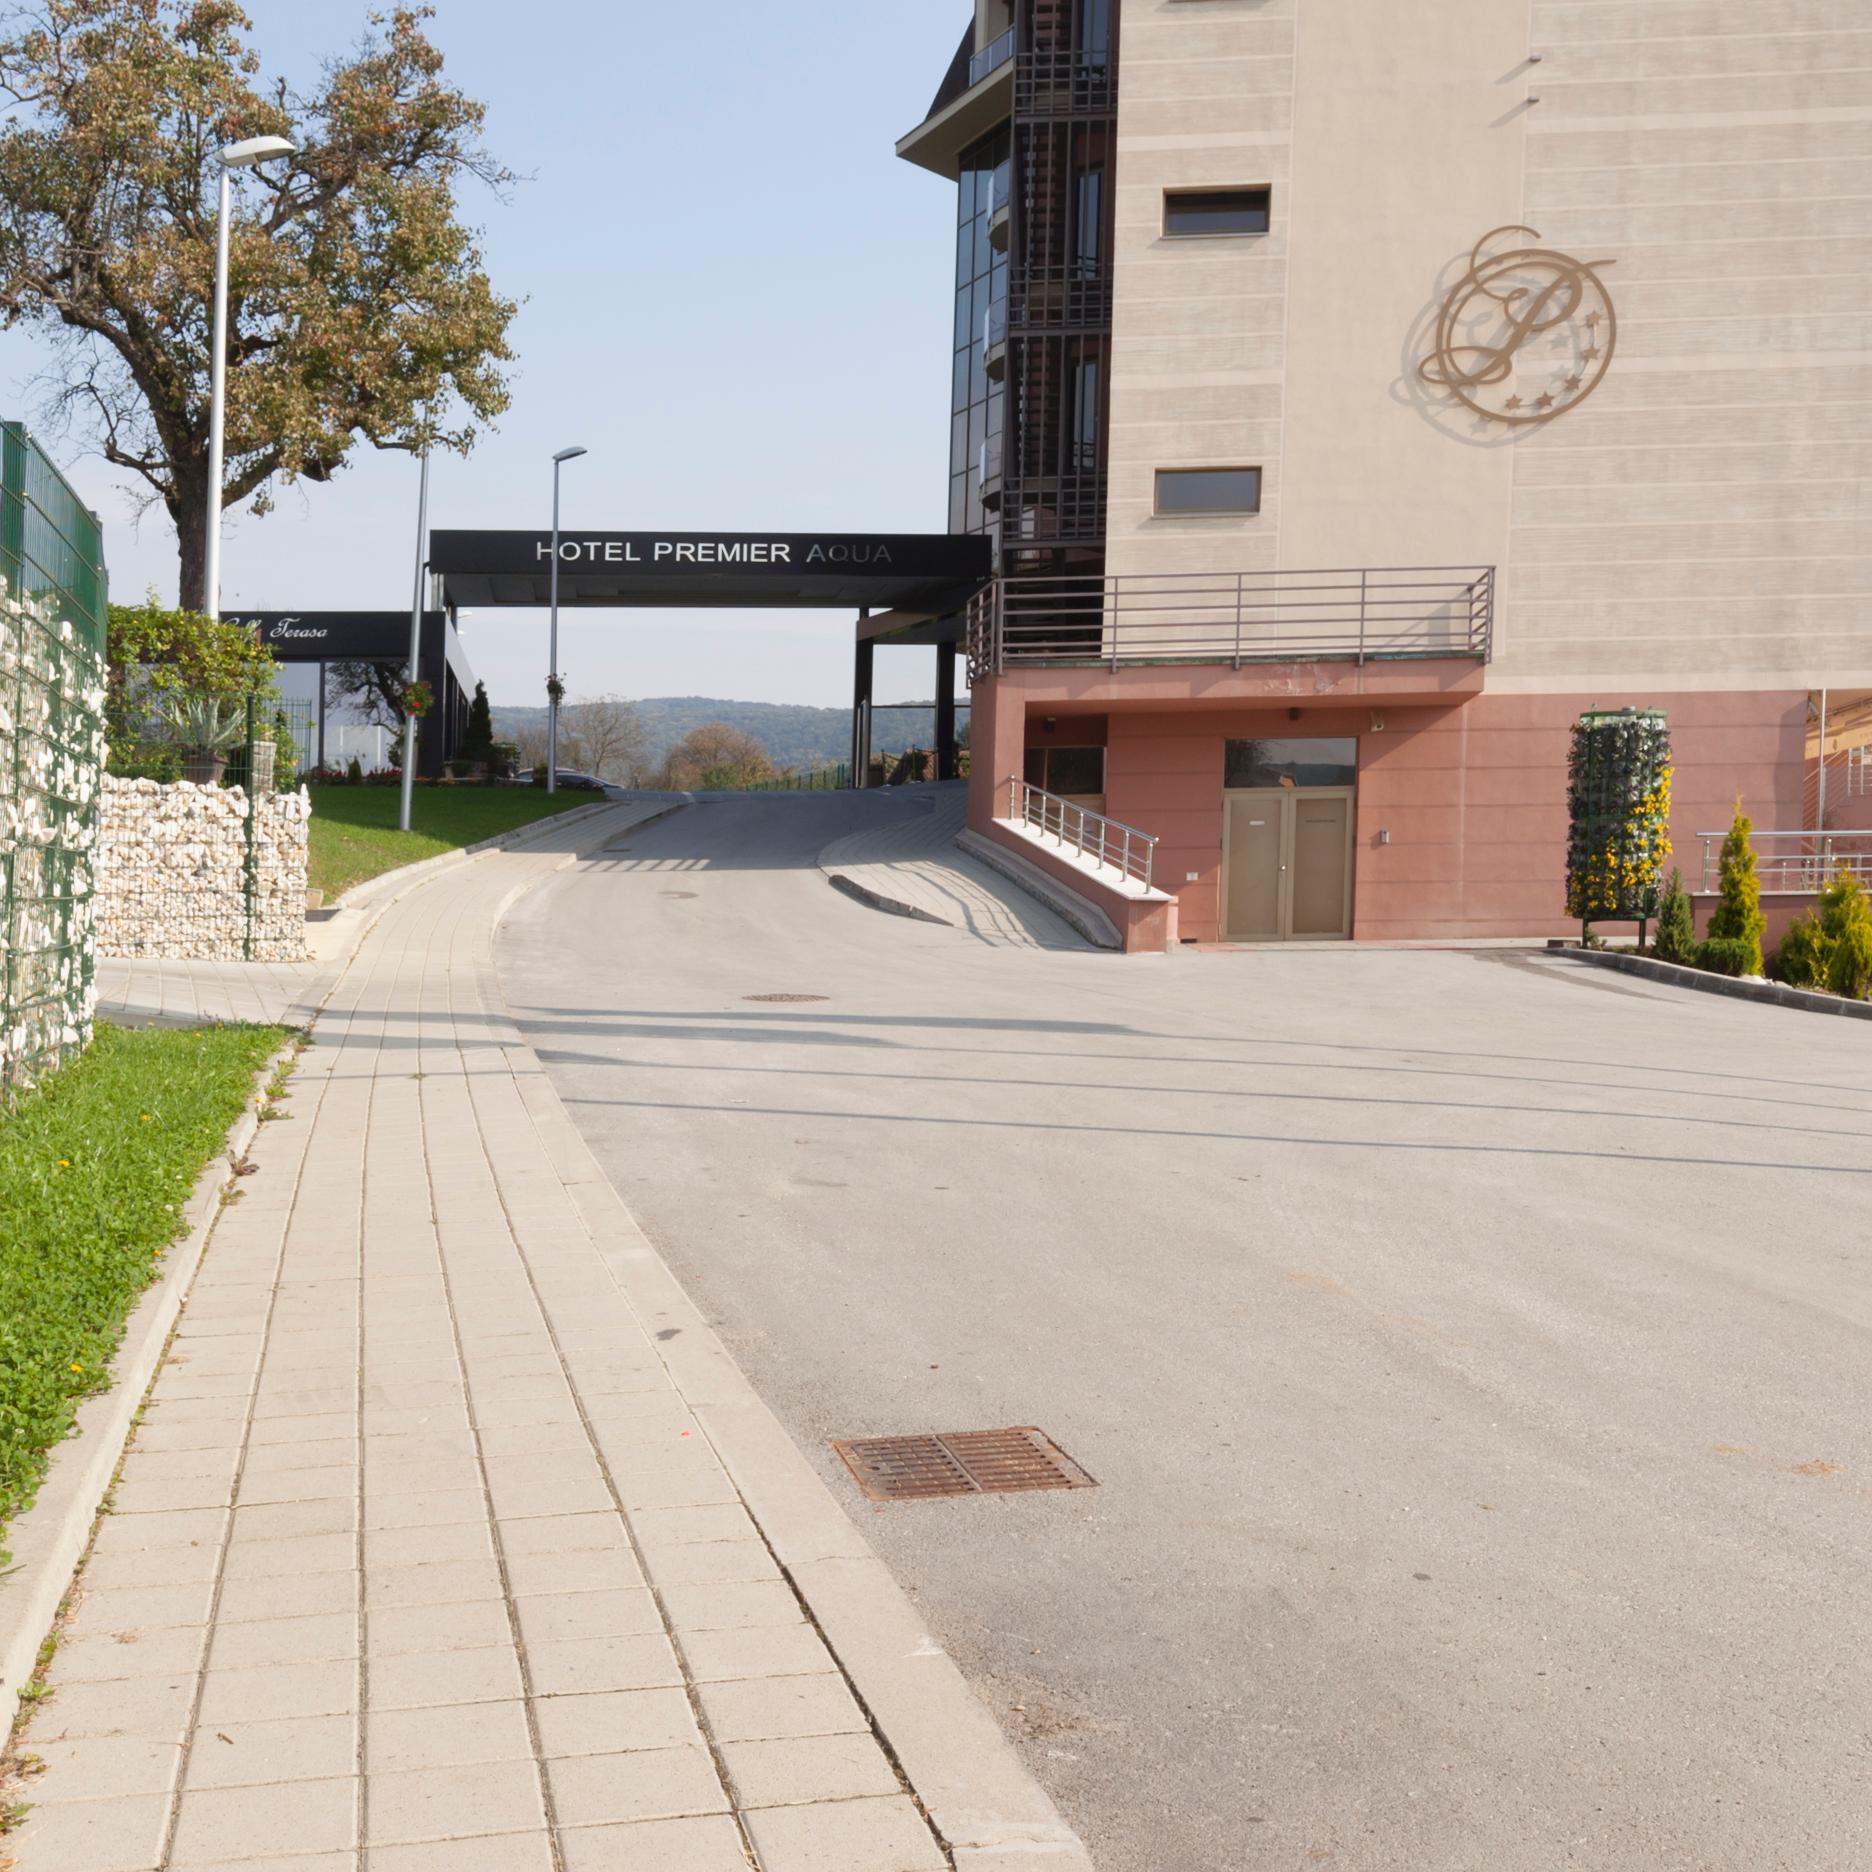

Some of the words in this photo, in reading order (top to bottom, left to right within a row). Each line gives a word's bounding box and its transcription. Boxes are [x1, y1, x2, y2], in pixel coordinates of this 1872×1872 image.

[537, 541, 641, 561] HOTEL
[653, 542, 791, 563] PREMIER
[805, 543, 893, 563] AQUA
[269, 617, 328, 638] Terasa
